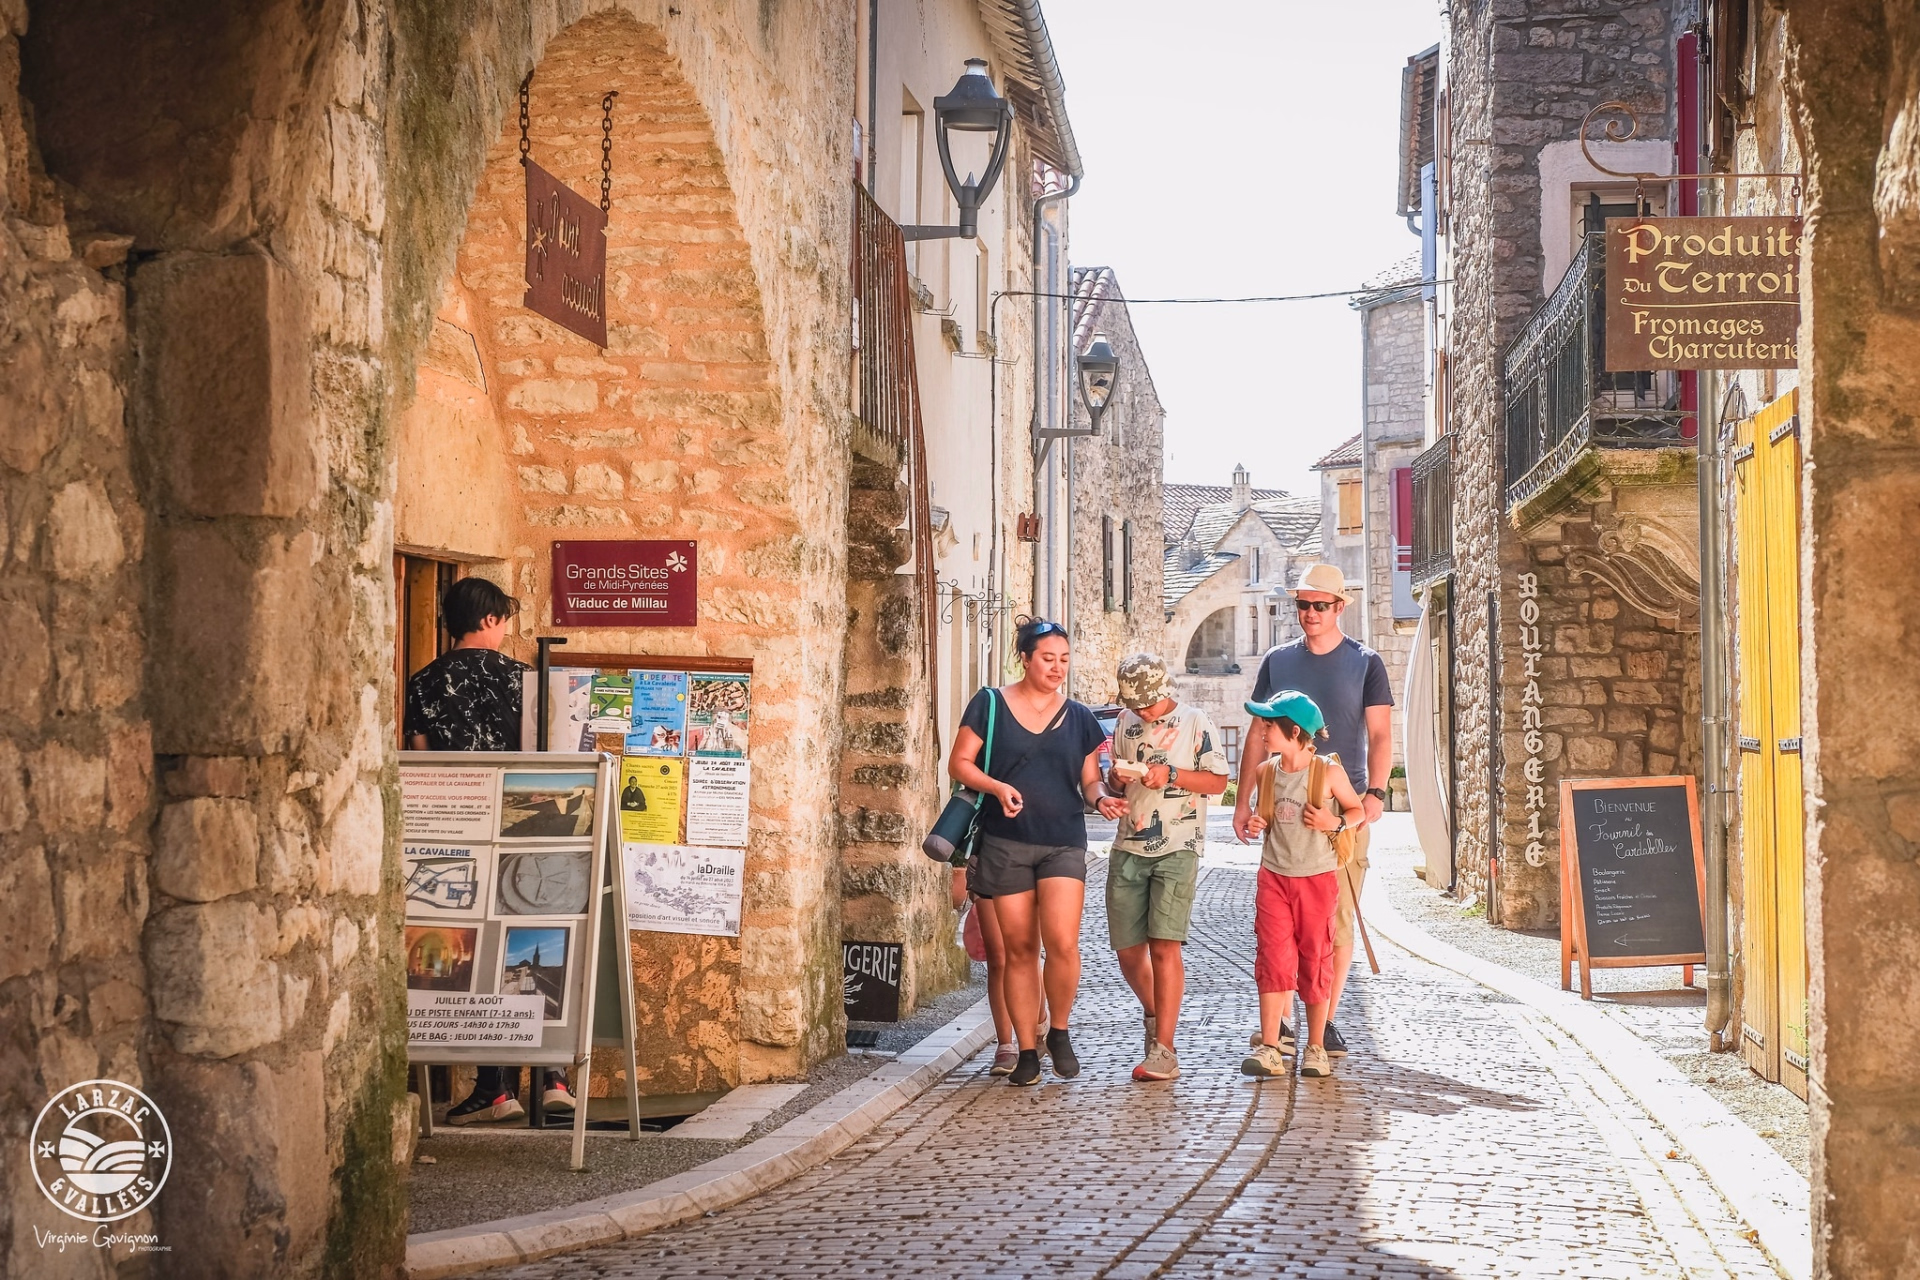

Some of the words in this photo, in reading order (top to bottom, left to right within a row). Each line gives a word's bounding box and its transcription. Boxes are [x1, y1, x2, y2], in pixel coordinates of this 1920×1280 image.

[549, 190, 580, 260] Point
[1622, 278, 1652, 294] Du
[1654, 261, 1801, 294] Terroi
[562, 272, 600, 323] accueil
[1630, 310, 1765, 340] Fromages
[566, 564, 626, 579] Grands
[628, 564, 669, 579] Sites
[584, 580, 596, 590] de
[598, 579, 669, 592] Midi-Pyrénées
[567, 598, 610, 608] Viaduc
[612, 598, 628, 608] de
[632, 598, 668, 608] Millau
[1518, 572, 1547, 868] BOULANGERIE
[1589, 818, 1642, 842] Fournil
[404, 847, 417, 855] LA
[419, 848, 470, 857] CAVALERIE
[697, 864, 735, 876] laDraille
[478, 996, 504, 1005] AOÛT
[489, 1010, 512, 1018] (7-12
[514, 1010, 535, 1018] ans):
